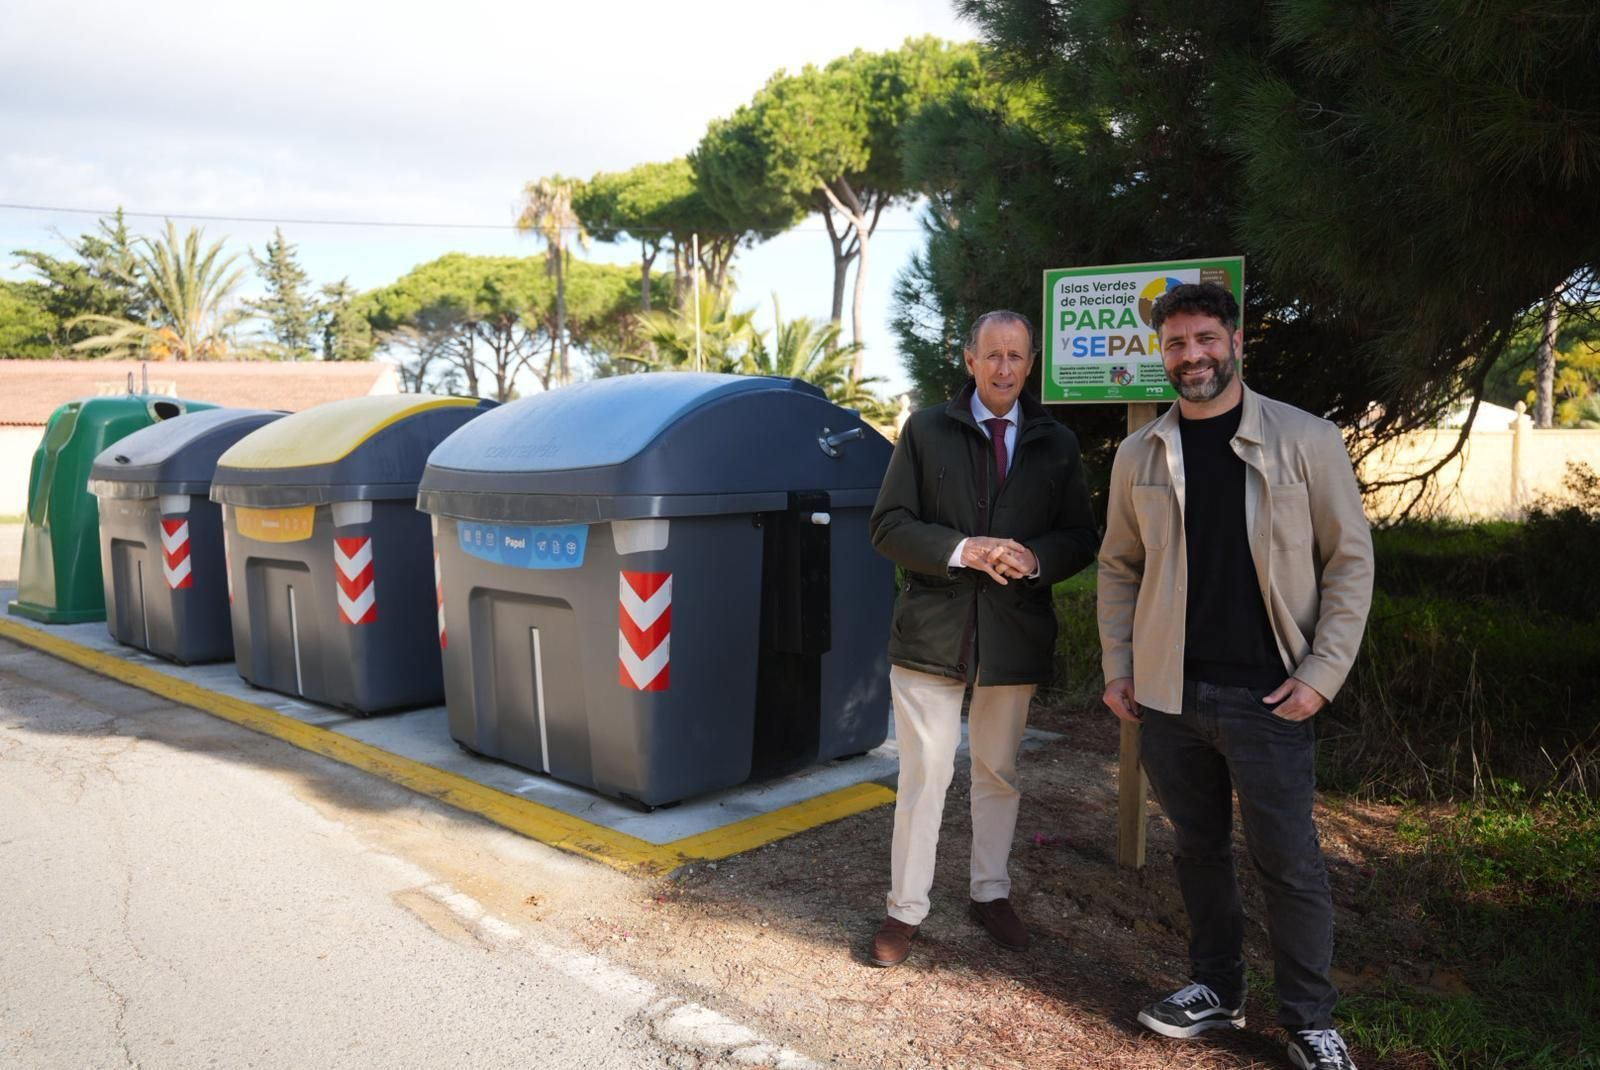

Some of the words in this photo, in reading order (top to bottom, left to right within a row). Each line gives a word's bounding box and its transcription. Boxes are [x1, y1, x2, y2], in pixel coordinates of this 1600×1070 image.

[1061, 283, 1089, 294] Islas
[1093, 280, 1137, 292] Verdes
[1060, 296, 1077, 307] de
[1080, 293, 1135, 306] Reciclaje
[1060, 307, 1138, 331] PARA
[1072, 334, 1161, 358] SEPAR
[505, 536, 525, 549] Papel
